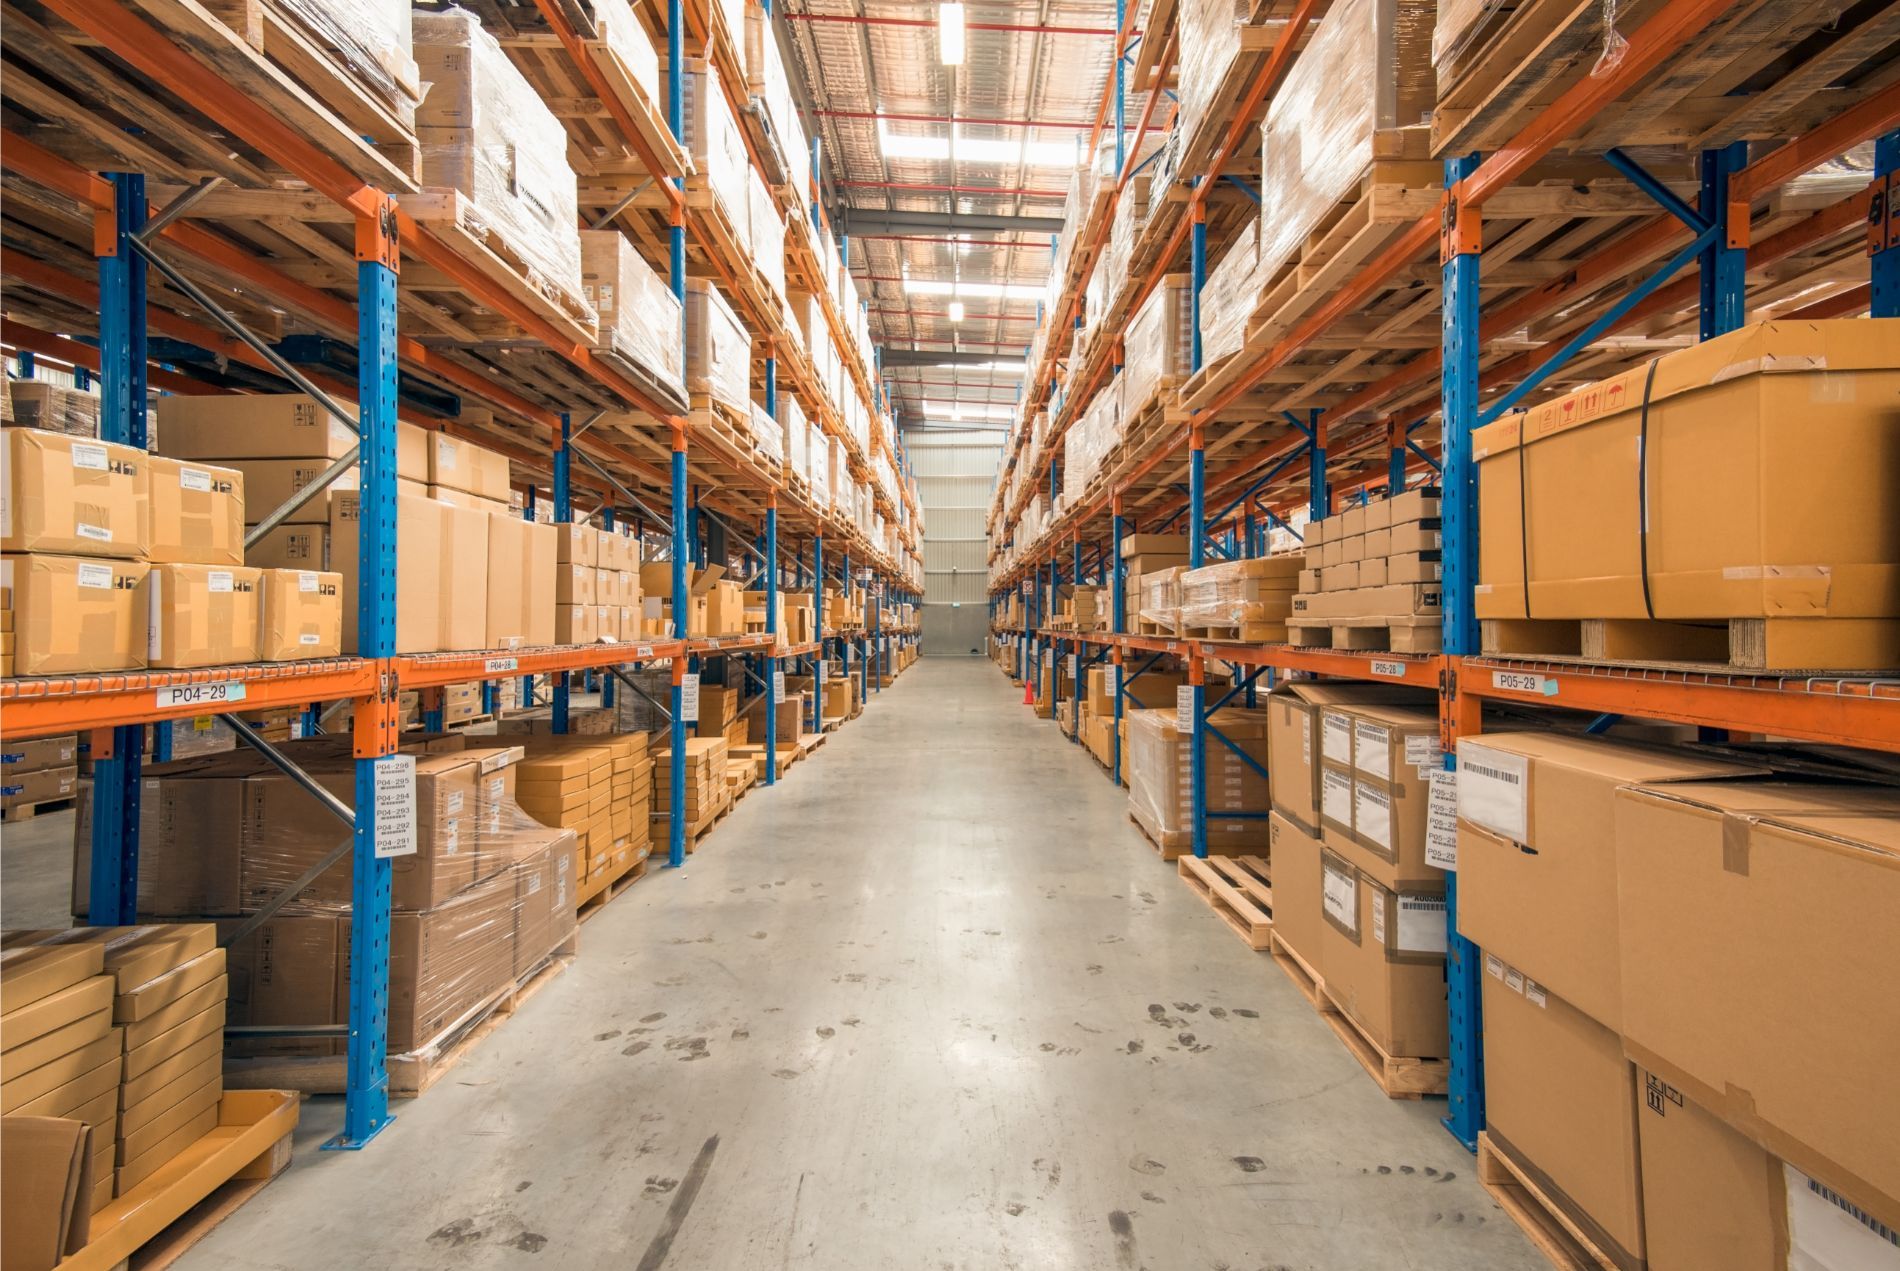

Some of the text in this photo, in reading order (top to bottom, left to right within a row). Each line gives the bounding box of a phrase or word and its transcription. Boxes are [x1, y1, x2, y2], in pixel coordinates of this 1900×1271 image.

[1500, 674, 1535, 690] P05-29
[172, 685, 226, 703] P04-29
[376, 778, 410, 786] P04-295
[376, 793, 410, 802] P04-294
[376, 807, 410, 816] P04-293
[376, 822, 410, 831] P04-292
[376, 837, 410, 847] P04-291
[1428, 832, 1457, 844] P05-29
[1427, 848, 1456, 860] P05-29
